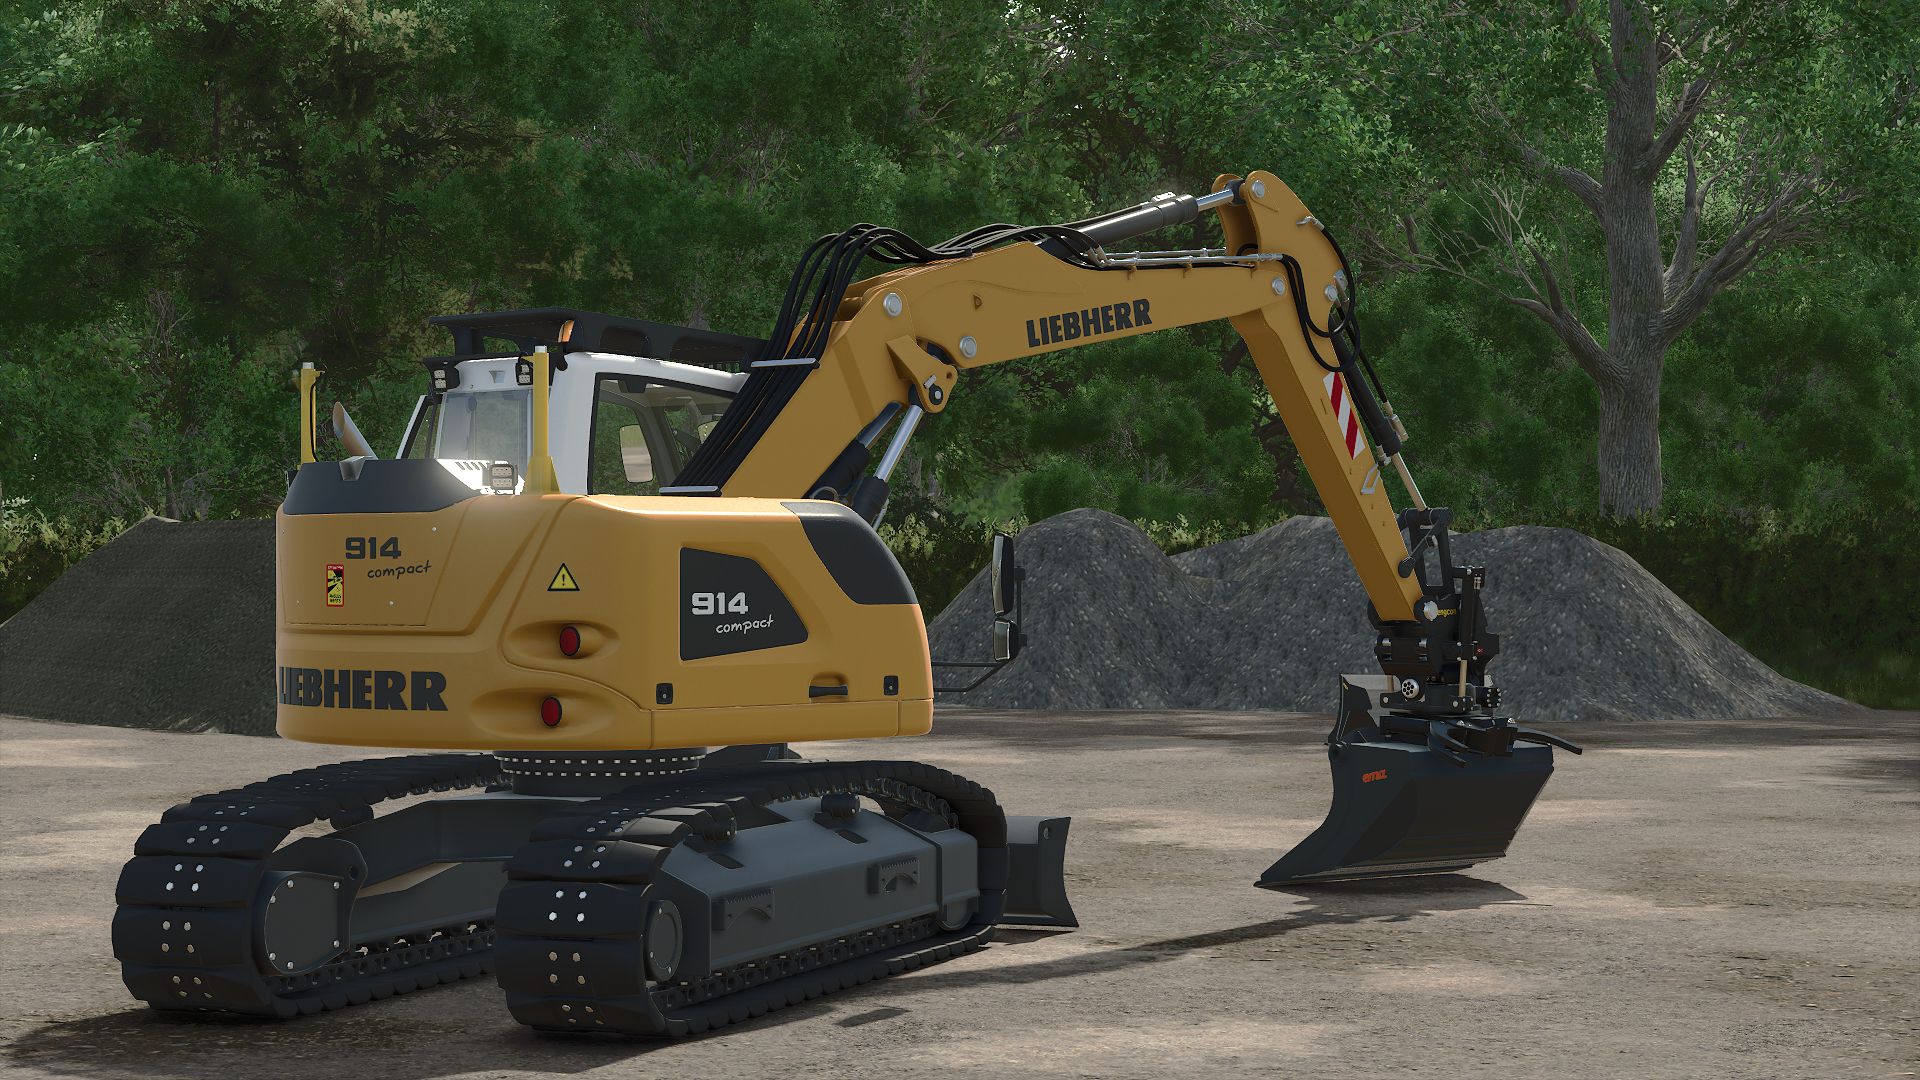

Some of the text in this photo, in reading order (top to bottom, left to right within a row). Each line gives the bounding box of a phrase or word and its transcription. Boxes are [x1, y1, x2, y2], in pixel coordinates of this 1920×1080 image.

[1026, 299, 1152, 348] LIEBHERR
[345, 536, 402, 560] 914
[367, 560, 432, 580] compact
[691, 592, 749, 615] 914
[716, 614, 774, 635] compact
[279, 666, 449, 711] LIEBHERR
